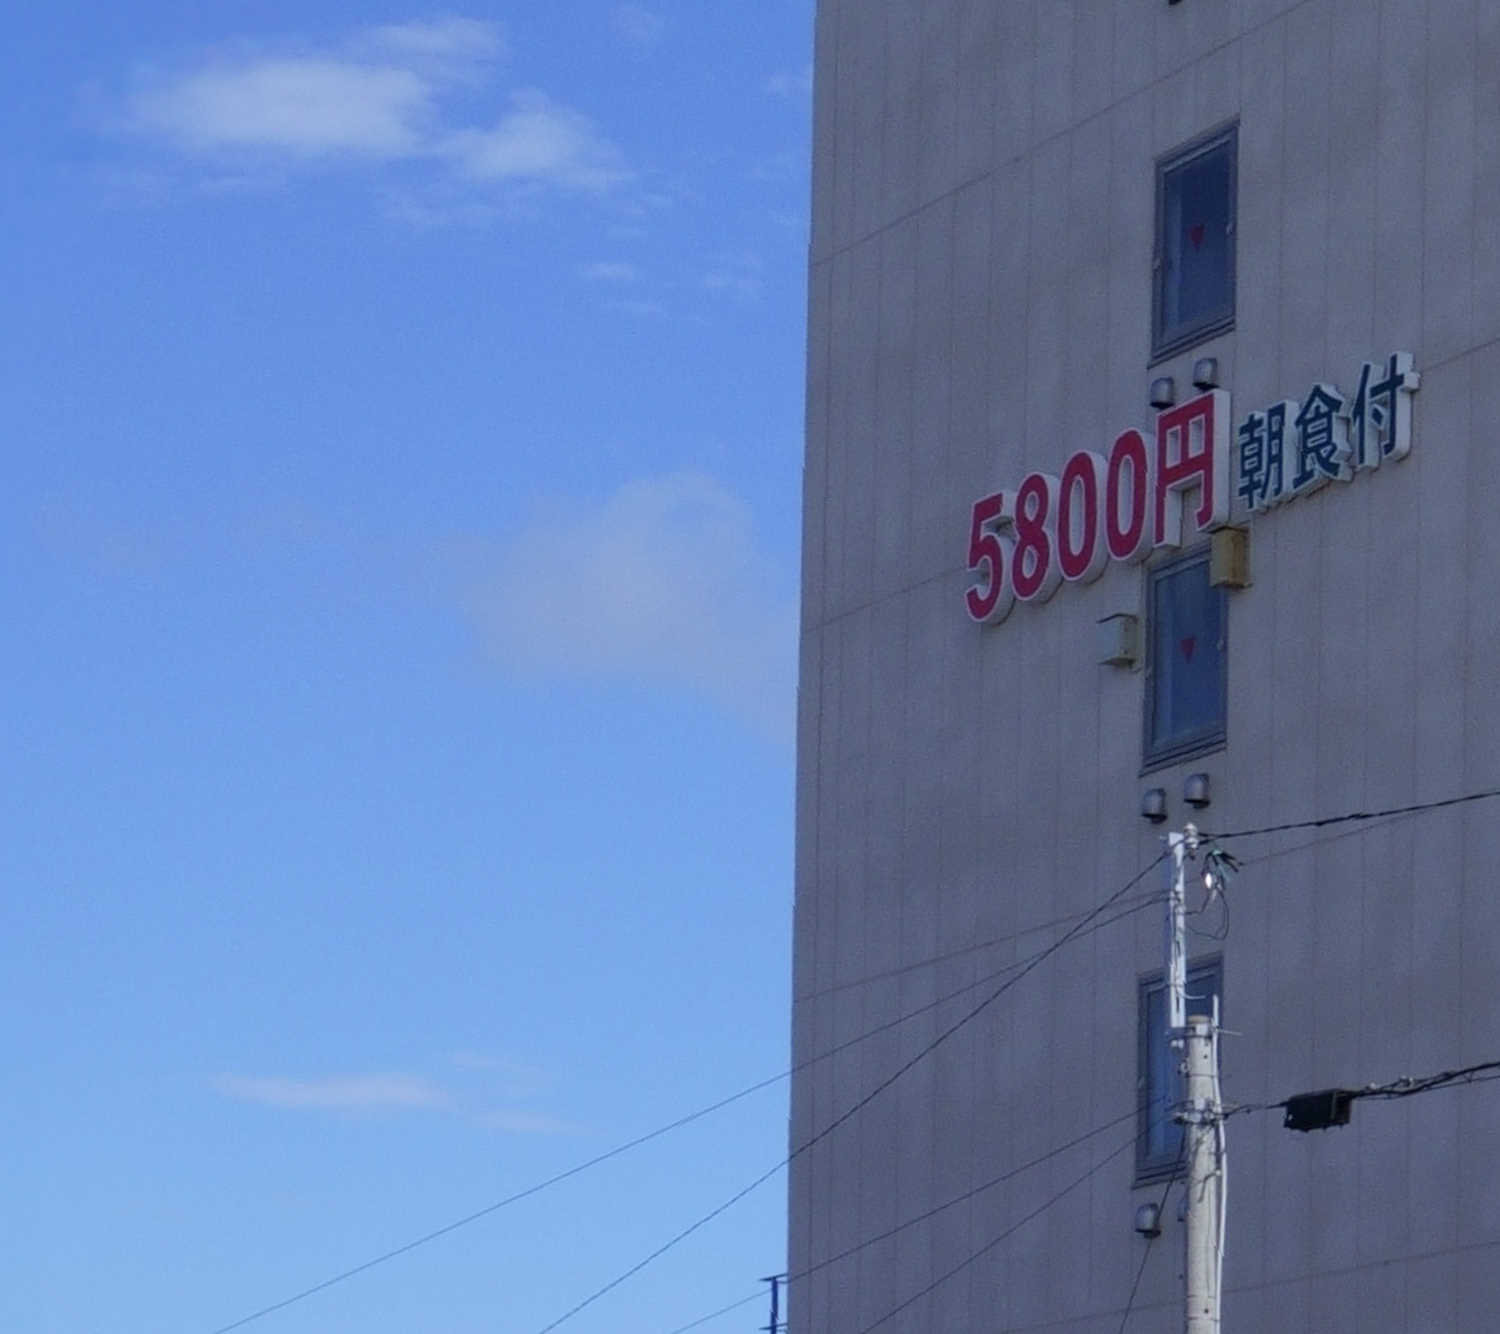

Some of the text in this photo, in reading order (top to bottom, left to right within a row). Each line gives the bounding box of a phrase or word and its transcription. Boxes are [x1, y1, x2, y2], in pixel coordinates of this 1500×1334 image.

[965, 351, 1412, 621] 5800円 朝食付
